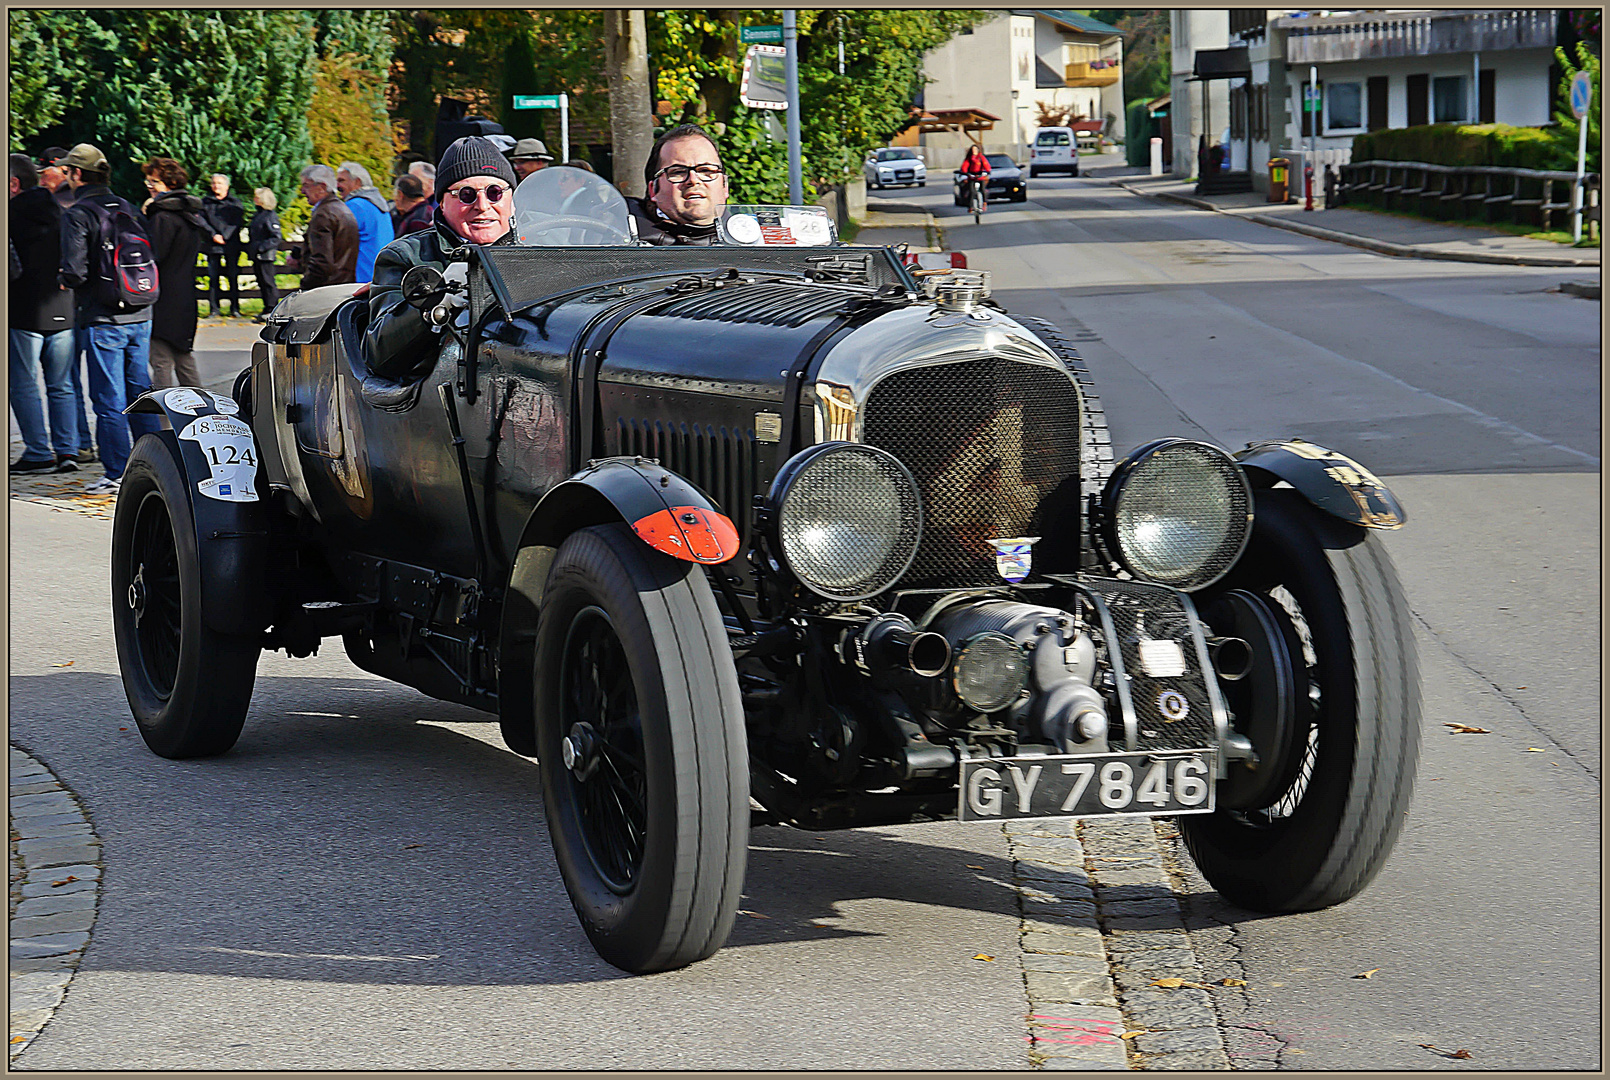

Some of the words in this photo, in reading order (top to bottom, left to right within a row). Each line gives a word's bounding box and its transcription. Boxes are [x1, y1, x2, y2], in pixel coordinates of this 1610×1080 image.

[744, 28, 781, 39] Sennerei
[207, 445, 256, 467] 124
[967, 764, 1044, 817] GY
[1060, 758, 1209, 812] 7846
